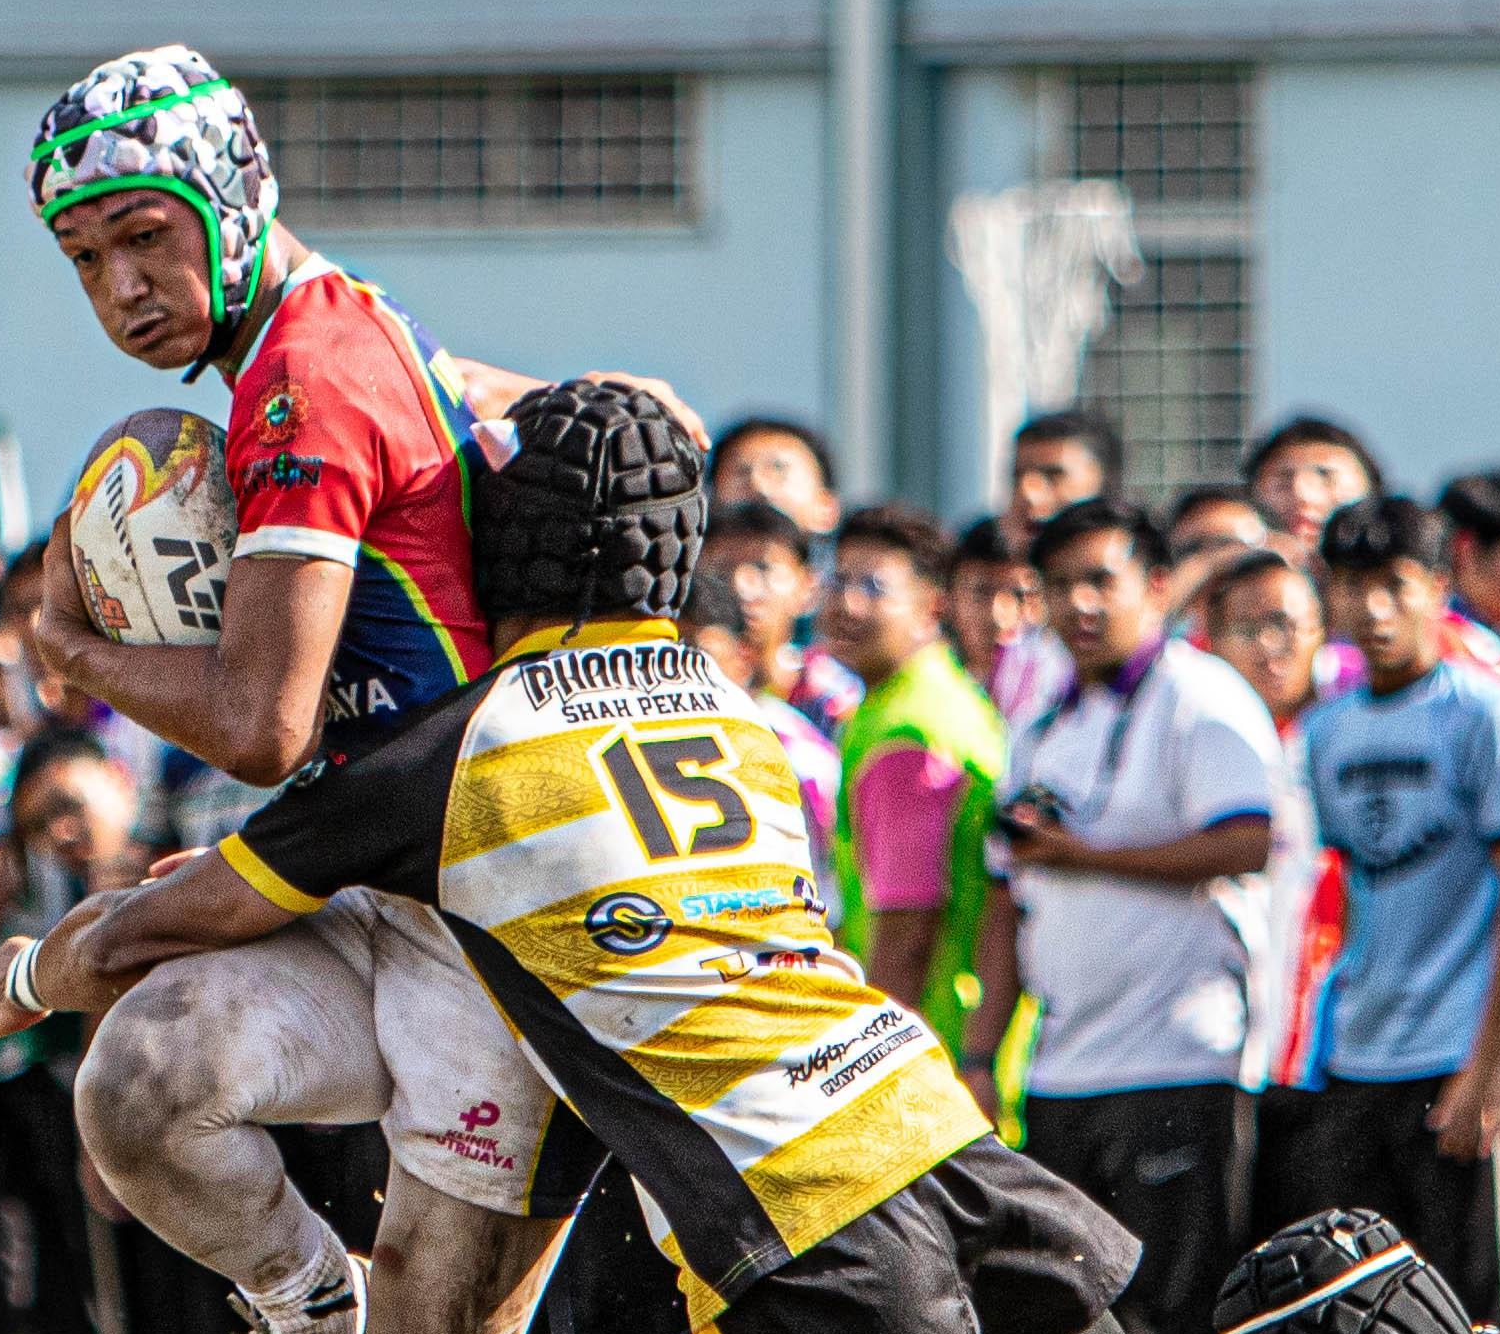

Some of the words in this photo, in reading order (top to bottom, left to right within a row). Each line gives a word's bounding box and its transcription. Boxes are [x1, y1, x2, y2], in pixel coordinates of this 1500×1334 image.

[561, 698, 633, 724] SHAH
[637, 692, 720, 717] PEKAN
[588, 721, 757, 862] 15
[820, 1061, 857, 1097] PLAY
[855, 1042, 891, 1074] WITH
